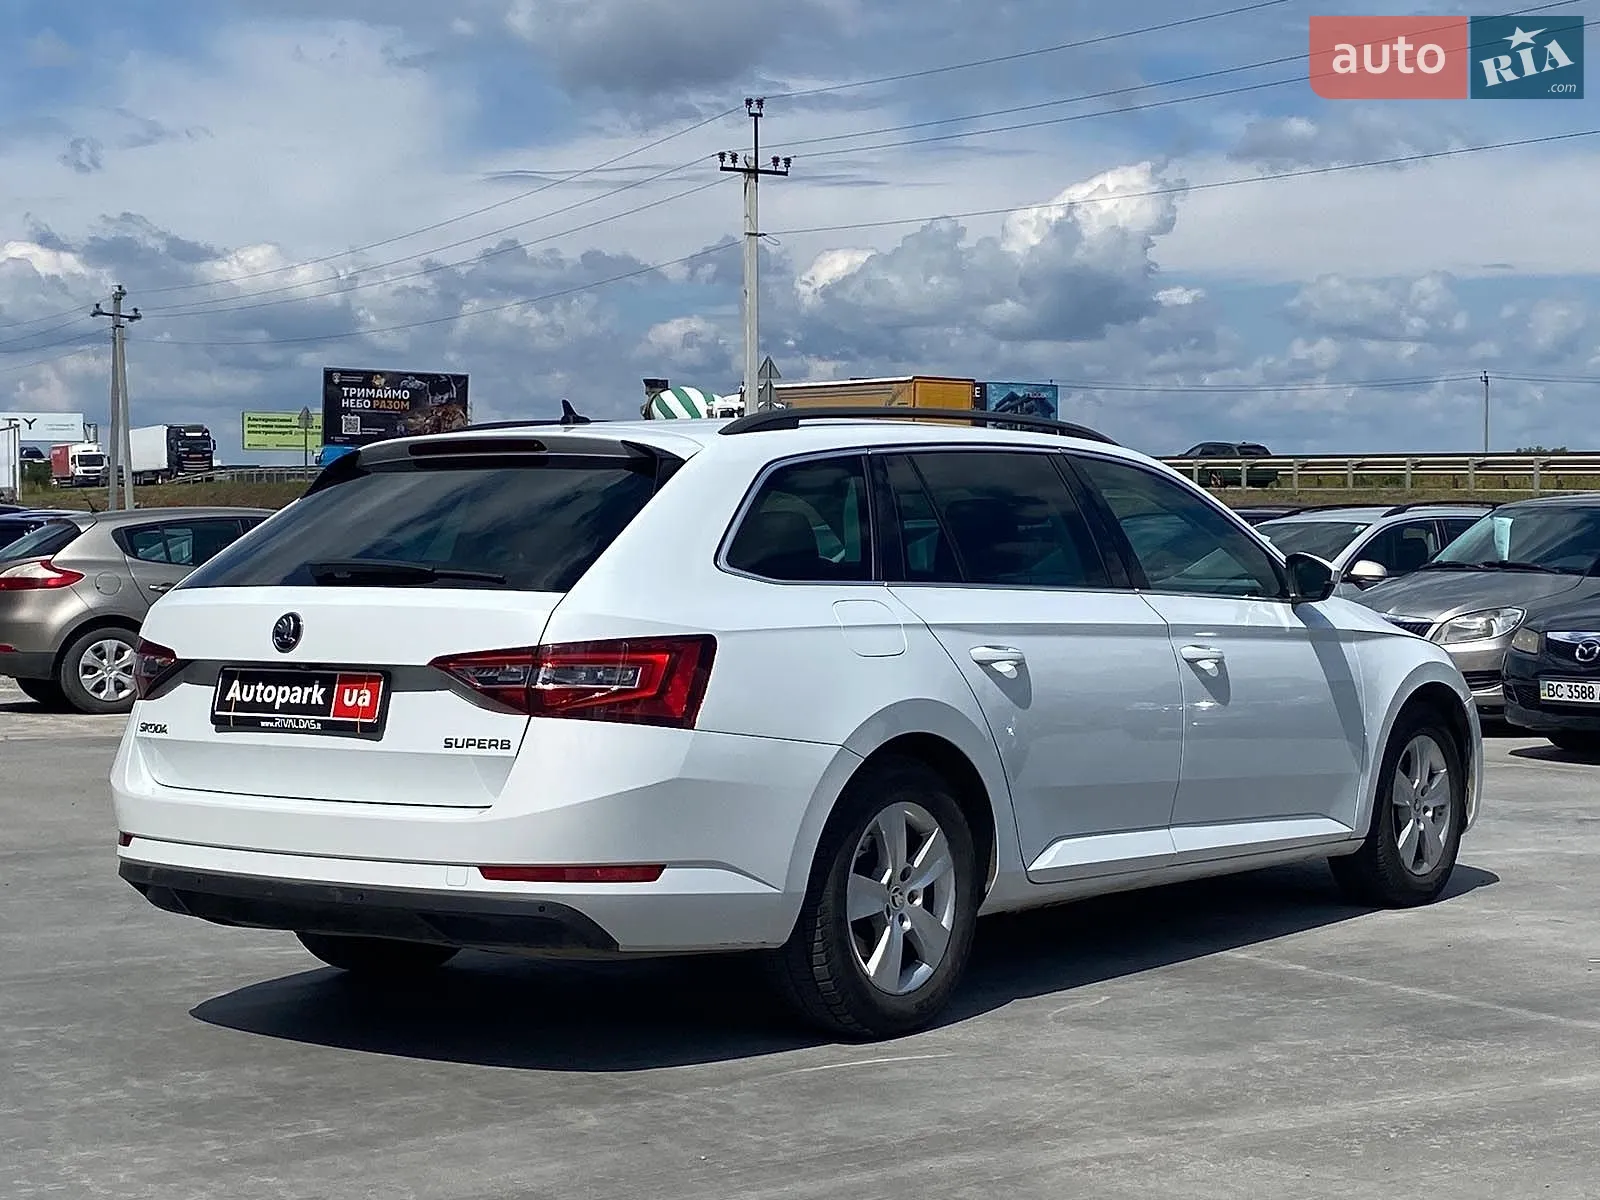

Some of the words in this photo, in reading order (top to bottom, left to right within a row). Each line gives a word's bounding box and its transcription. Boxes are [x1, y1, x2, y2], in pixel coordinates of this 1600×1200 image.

[341, 386, 410, 400] ТРИМАЙМО
[341, 398, 371, 409] НЕБО
[372, 400, 410, 410] РАЗОМ
[225, 680, 326, 710] Autopark
[343, 688, 371, 707] ua
[1547, 683, 1564, 698] BC
[1566, 684, 1595, 700] 3588
[443, 737, 511, 750] SUPERB
